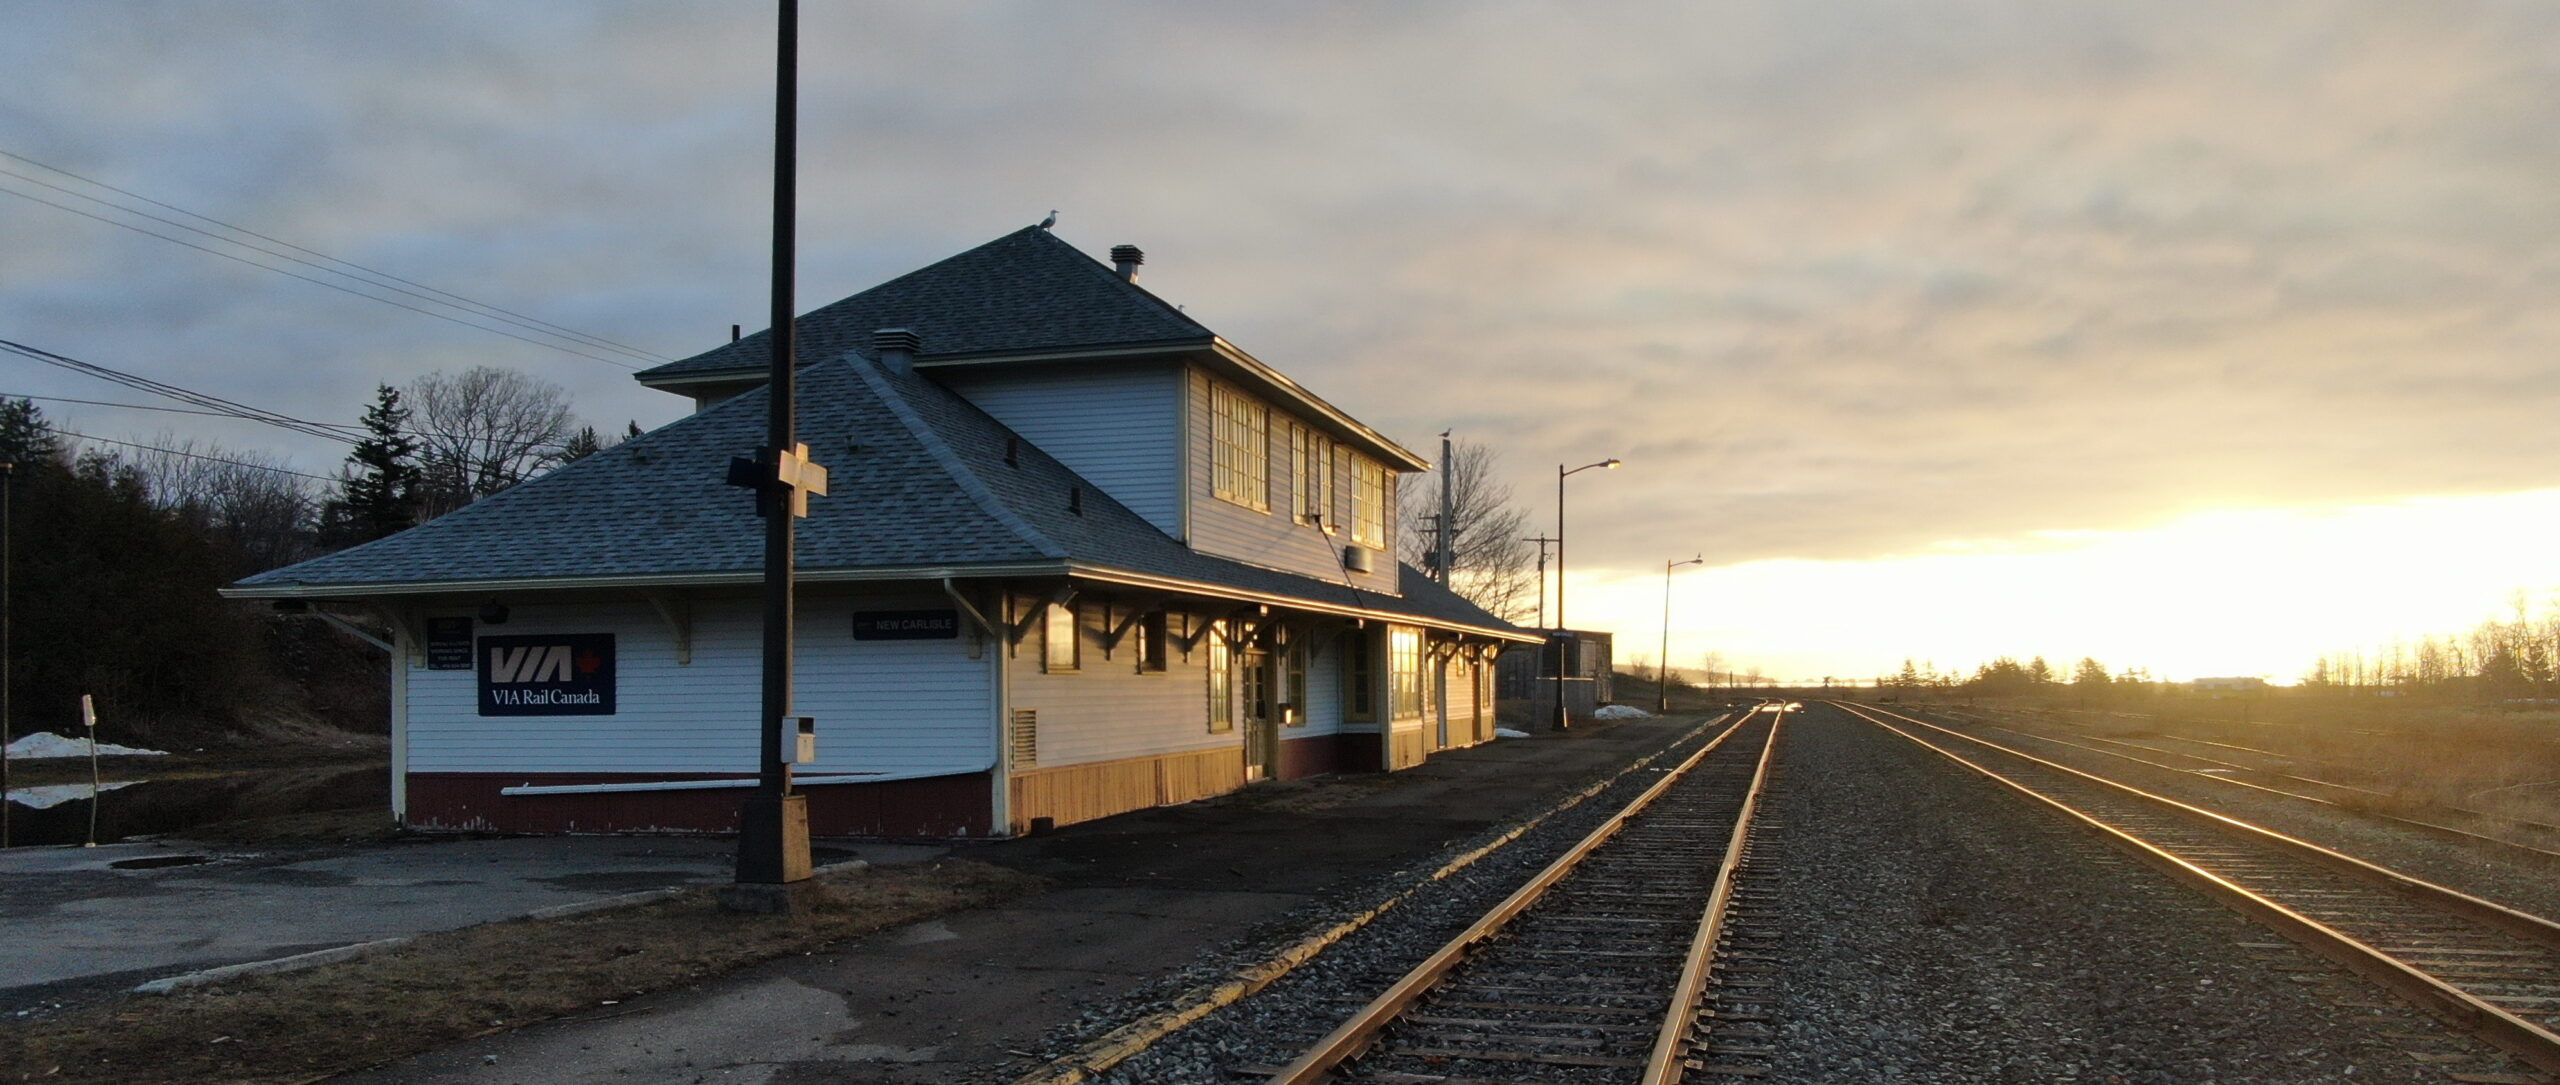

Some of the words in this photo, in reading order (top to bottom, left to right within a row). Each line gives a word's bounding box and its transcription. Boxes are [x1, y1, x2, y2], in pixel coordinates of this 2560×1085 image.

[876, 619, 900, 630] NEW
[902, 618, 953, 630] CARLISLE
[491, 645, 572, 683] VIA
[492, 689, 521, 705] VIA
[523, 689, 549, 705] Rail
[550, 688, 600, 705] Canada
